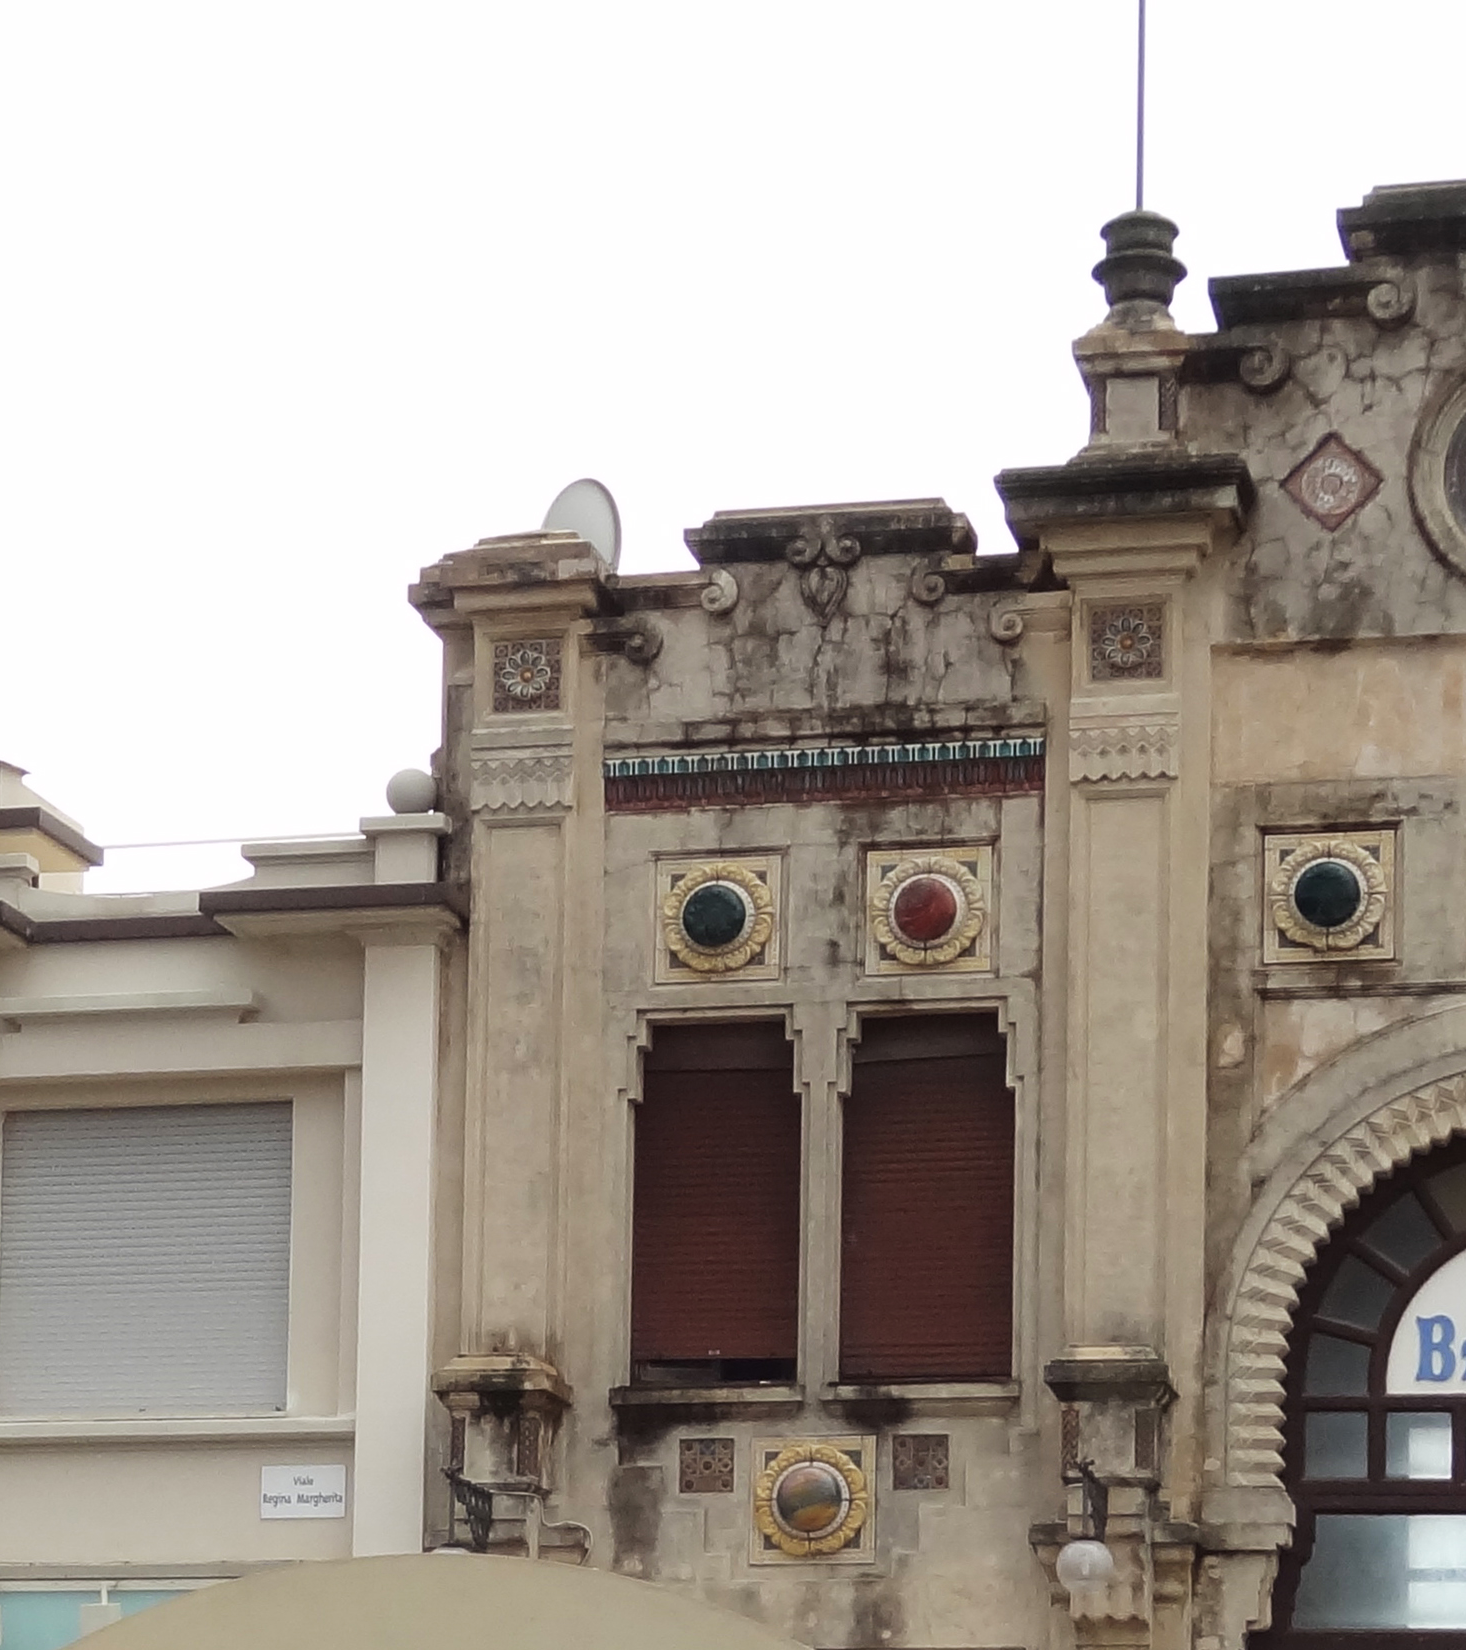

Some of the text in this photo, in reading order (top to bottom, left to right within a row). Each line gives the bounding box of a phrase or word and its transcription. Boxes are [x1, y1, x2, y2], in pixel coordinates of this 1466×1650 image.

[293, 1476, 314, 1486] Viale
[262, 1491, 343, 1508] Regina Margherita
